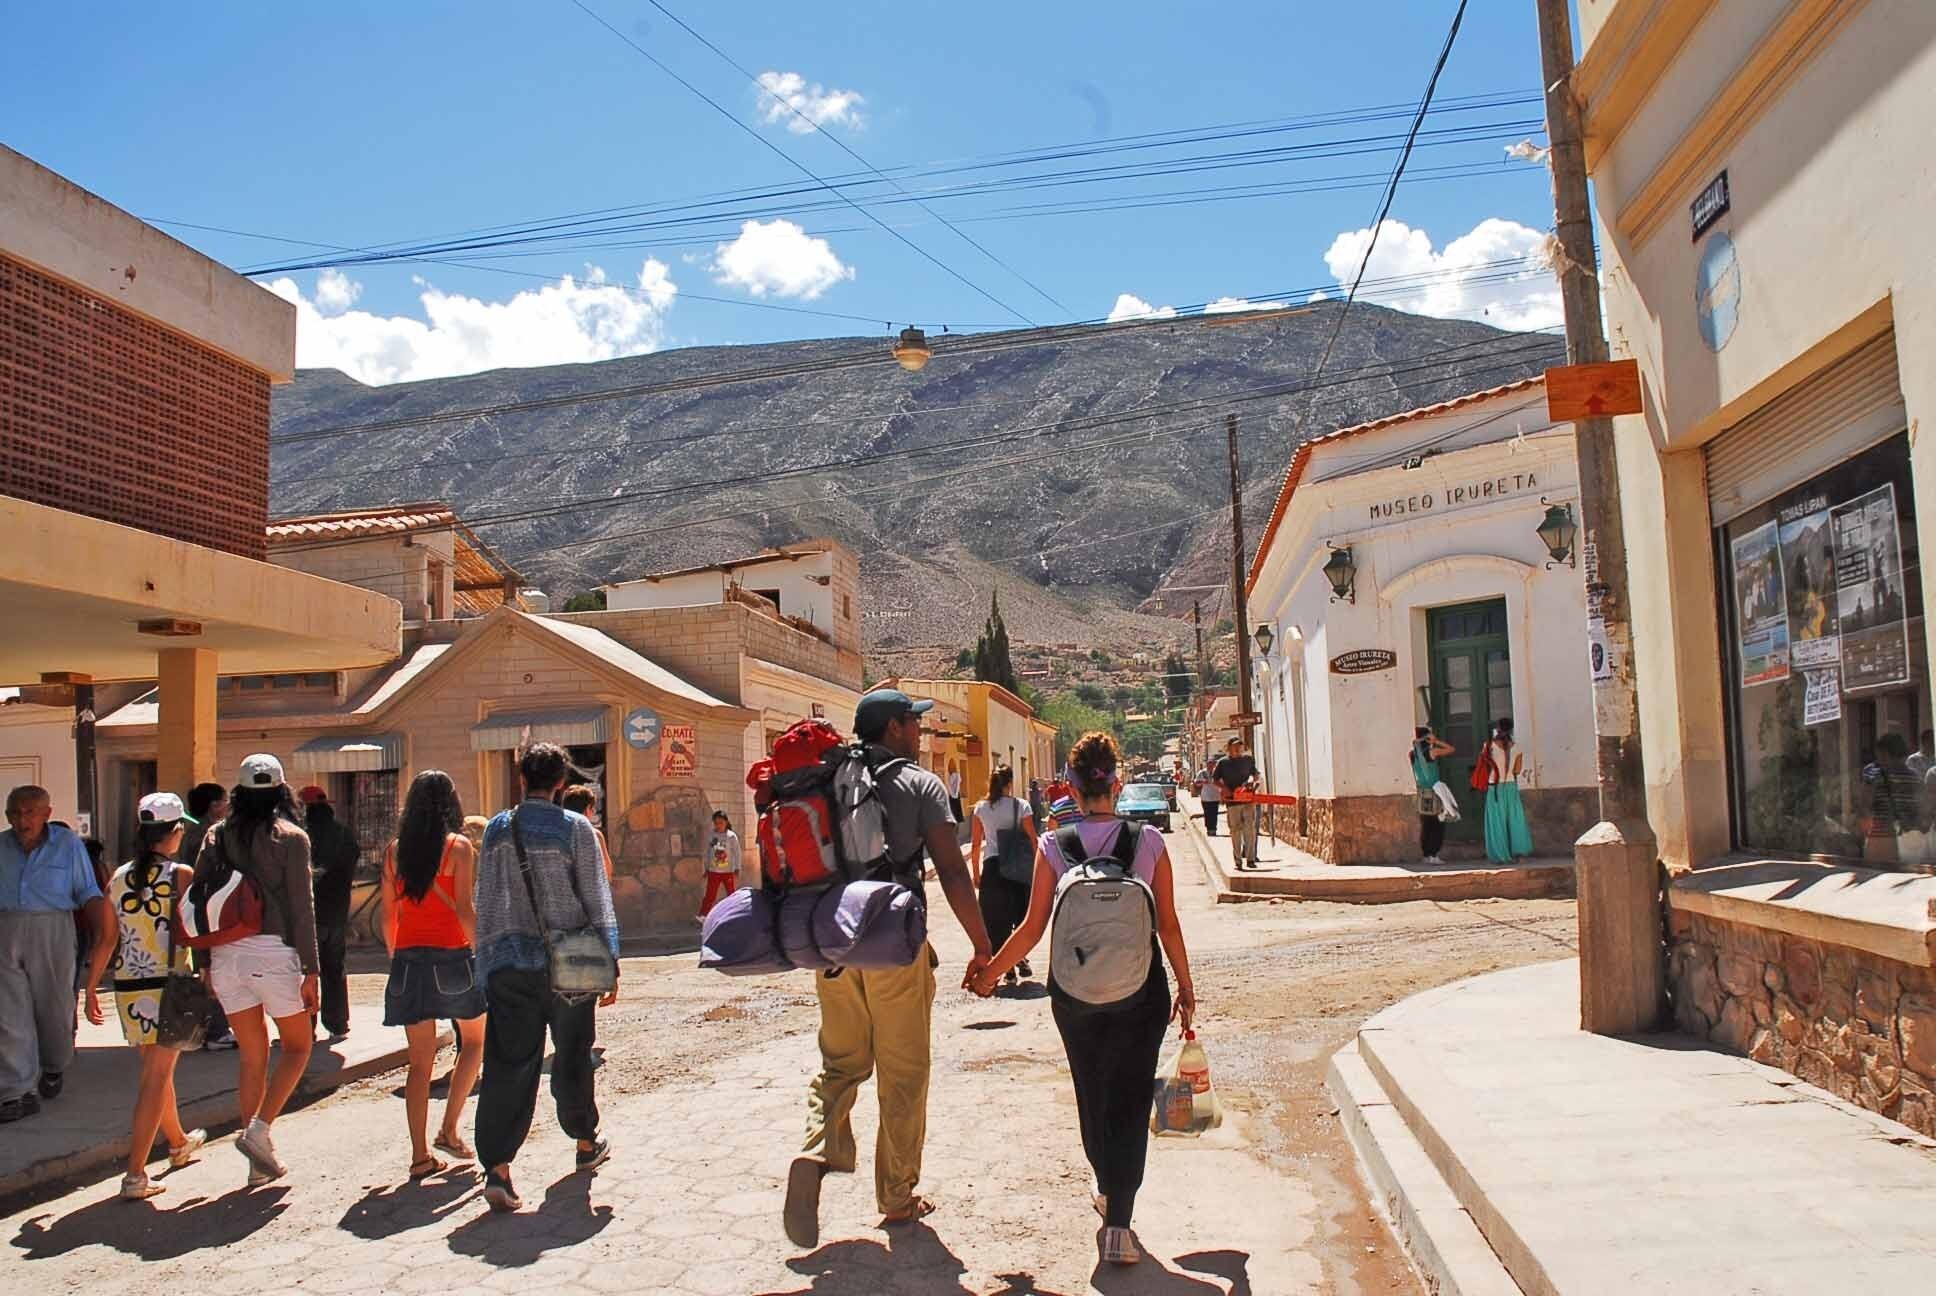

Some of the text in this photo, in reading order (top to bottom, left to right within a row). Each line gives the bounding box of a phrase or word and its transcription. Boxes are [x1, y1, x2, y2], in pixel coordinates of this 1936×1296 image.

[1369, 472, 1537, 520] MUSEO IRURETA
[1335, 652, 1359, 668] MUSEO
[1360, 650, 1391, 661] IRURETA
